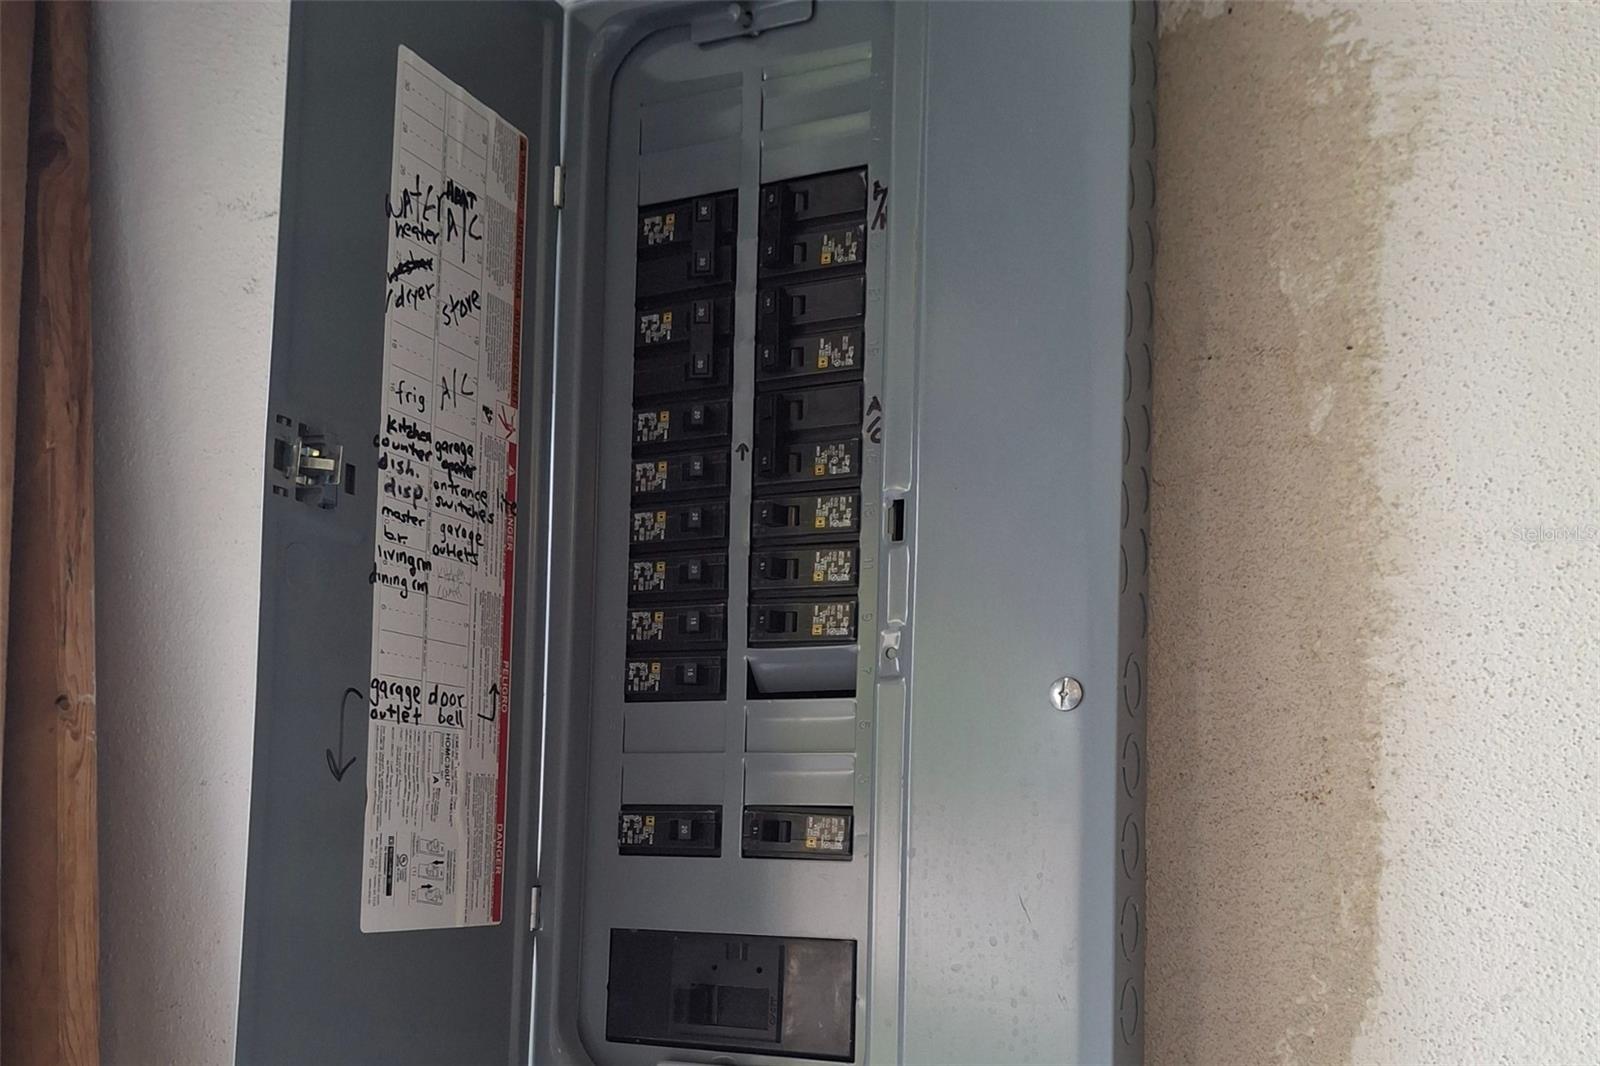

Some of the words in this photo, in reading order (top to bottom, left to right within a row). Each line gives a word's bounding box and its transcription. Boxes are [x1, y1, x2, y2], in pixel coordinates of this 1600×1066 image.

[395, 220, 440, 244] heater
[447, 206, 482, 264] A/C
[395, 380, 426, 413] frig
[440, 368, 474, 411] A/C
[372, 434, 433, 462] counter
[434, 440, 474, 466] garage
[433, 480, 488, 508] entrance
[381, 505, 426, 527] master
[435, 496, 494, 525] switches
[383, 524, 408, 545] br.
[440, 523, 484, 553] garage
[369, 561, 408, 599] dining
[369, 678, 421, 711] garage
[428, 684, 465, 708] door
[501, 660, 511, 713] PELIGRO
[370, 704, 422, 726] outlet
[438, 706, 464, 728] bell
[495, 823, 504, 875] DANGER
